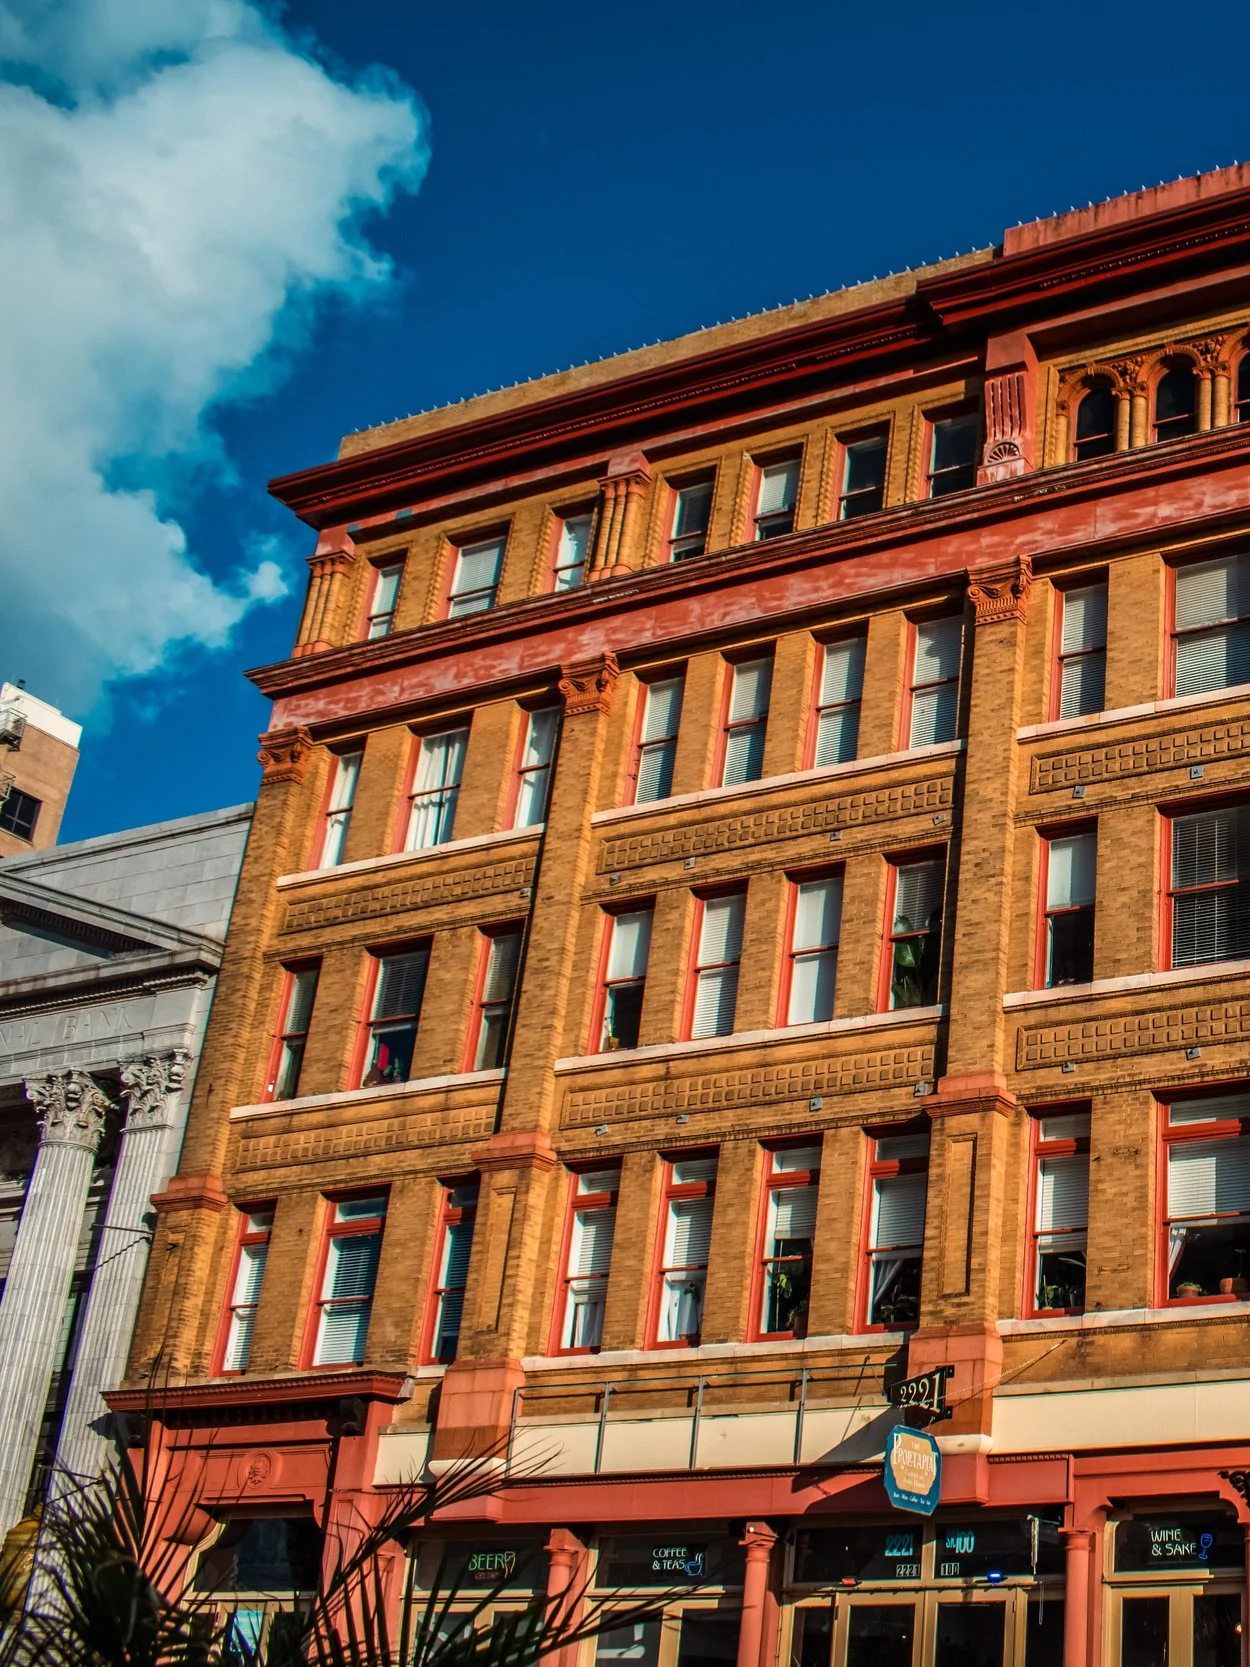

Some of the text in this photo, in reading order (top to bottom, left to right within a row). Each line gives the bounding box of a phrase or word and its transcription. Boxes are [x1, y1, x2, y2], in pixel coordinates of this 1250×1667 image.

[62, 1004, 134, 1039] BANK
[900, 1371, 941, 1414] 2221
[1151, 1528, 1181, 1543] WINE
[885, 1533, 914, 1556] 2221
[1152, 1543, 1197, 1557] & SAKE
[652, 1547, 687, 1558] COFFEE
[468, 1553, 505, 1571] BEER
[652, 1559, 686, 1571] & TEAS
[897, 1564, 920, 1577] 2221
